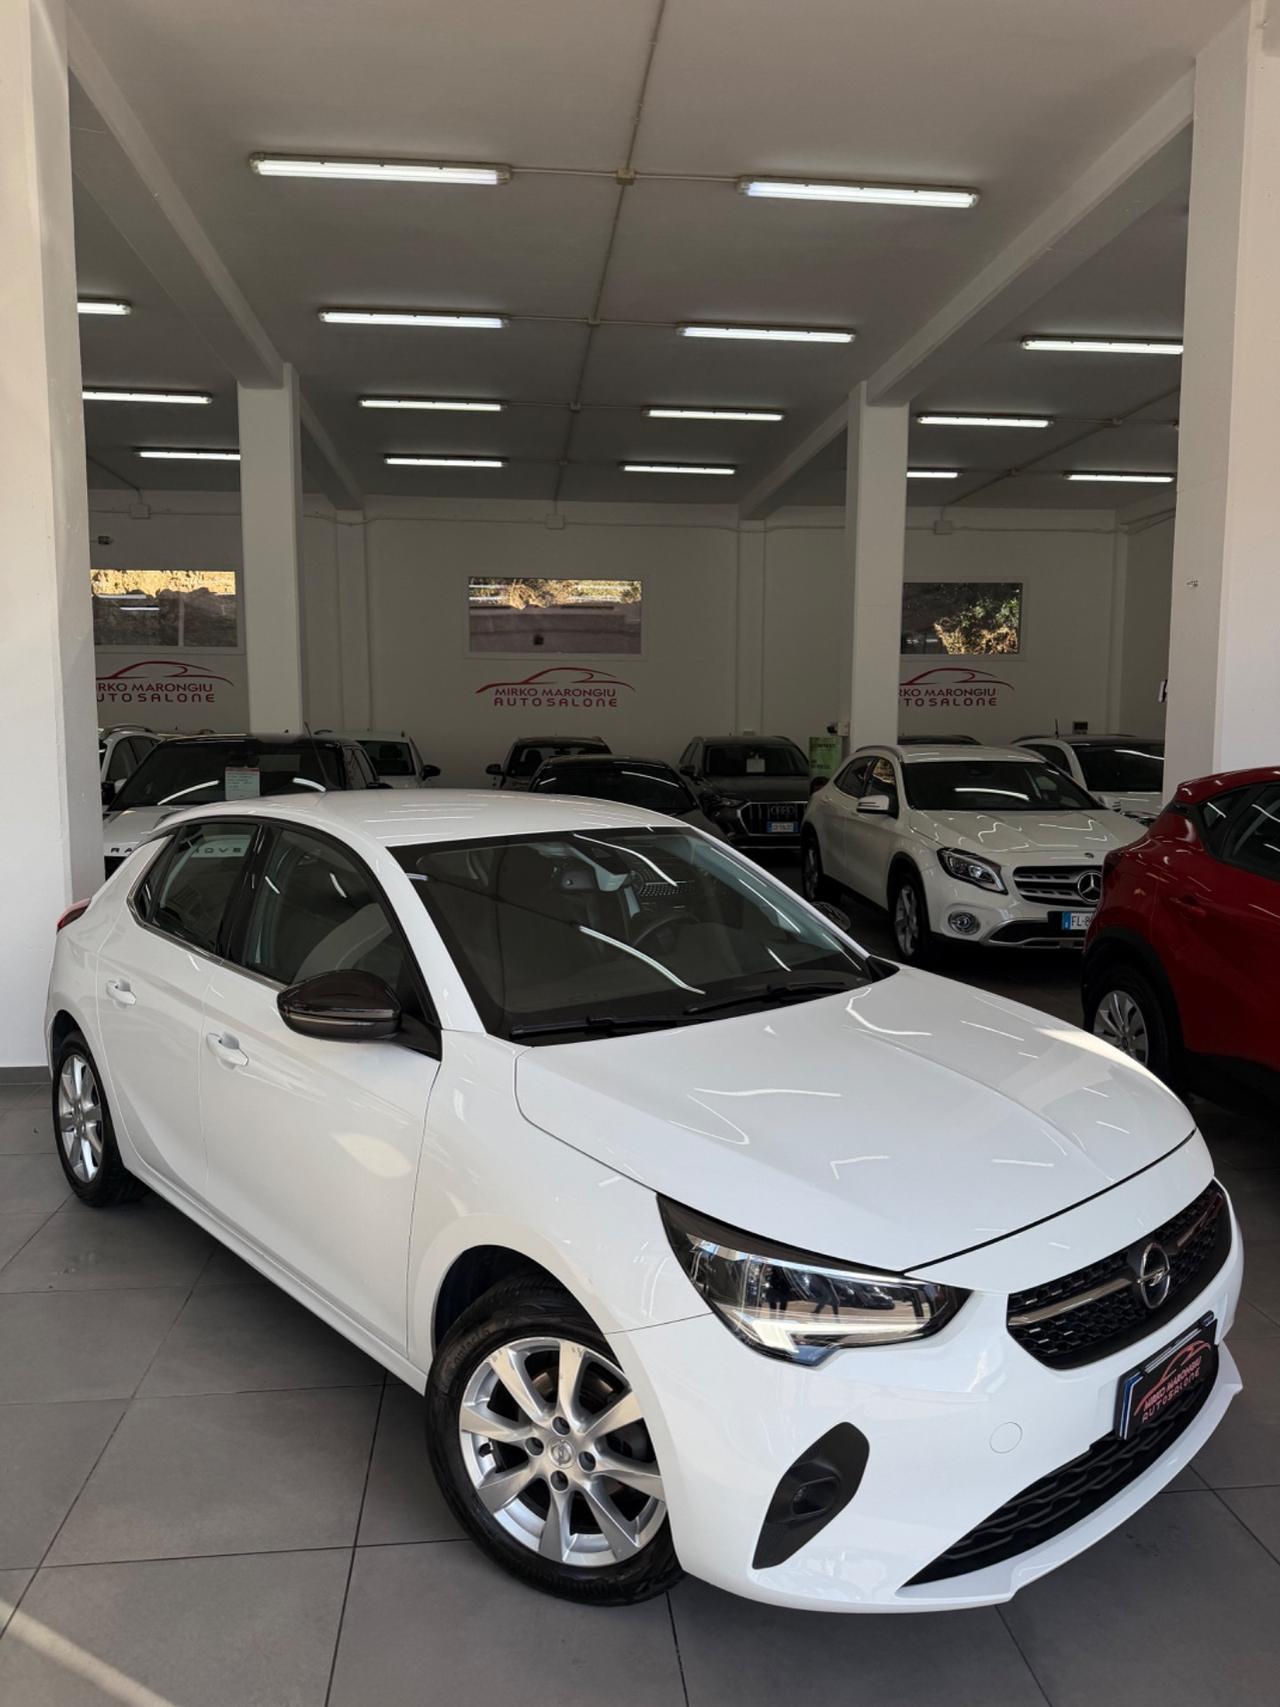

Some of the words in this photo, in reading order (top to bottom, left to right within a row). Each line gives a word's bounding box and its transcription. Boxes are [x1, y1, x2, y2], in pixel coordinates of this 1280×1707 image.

[97, 683, 128, 692] RKO
[131, 683, 213, 692] MARONGIU
[495, 688, 538, 697] MIRKO
[541, 688, 616, 697] MARONGIU
[924, 688, 996, 697] MARONGIU
[97, 693, 215, 703] UTOSALONE
[494, 697, 617, 707] AUTOSALONE
[904, 697, 997, 707] TOSALONE
